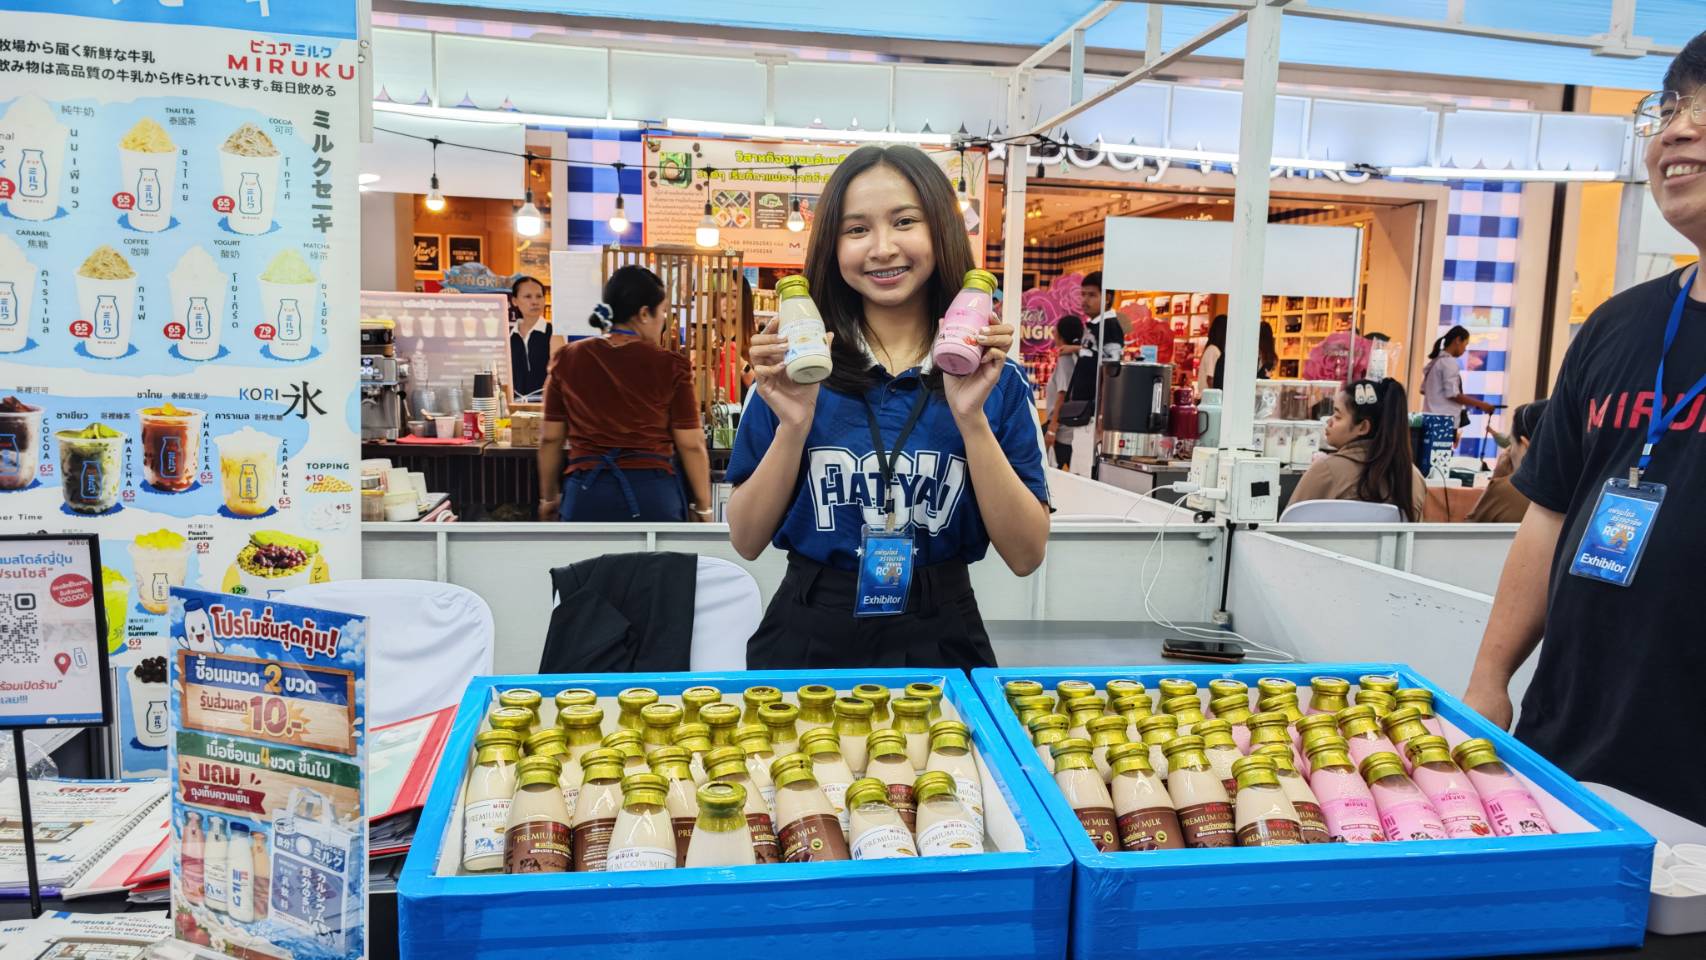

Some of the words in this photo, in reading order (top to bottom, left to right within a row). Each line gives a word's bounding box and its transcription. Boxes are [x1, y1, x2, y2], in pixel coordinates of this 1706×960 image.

[228, 55, 355, 80] MIRUKU
[312, 109, 334, 233] ミルクセーキ
[116, 194, 131, 204] 65
[217, 199, 230, 207] 65
[74, 323, 88, 332] 65
[258, 327, 271, 335] 79
[136, 389, 162, 399] ชาไทย
[239, 387, 279, 401] KORI
[281, 380, 327, 420] 氷
[56, 410, 89, 420] ชาเขียว
[215, 412, 250, 420] คาราเมล
[42, 418, 50, 460] COCOA
[125, 438, 133, 487] MATCHA
[306, 462, 350, 470] TOPPING
[39, 464, 54, 473] 65
[200, 471, 213, 480] 65
[122, 490, 135, 498] 65
[808, 446, 967, 537] PSU
[278, 497, 291, 506] 65
[196, 542, 209, 550] 69
[1580, 552, 1626, 573] Exhibitor
[231, 586, 247, 595] 129
[863, 595, 901, 605] Exhibitor
[210, 606, 338, 656] โปรโมชั่นสุดคุ้ม!
[128, 639, 142, 647] 69
[196, 654, 260, 687] ซื้อนมขวด
[264, 664, 283, 693] 2
[285, 677, 317, 695] ขวด
[200, 691, 248, 713] รับส่วนลด
[299, 750, 331, 778] ขึ้นไป
[198, 763, 241, 786] แถม
[191, 785, 250, 805] ถุงเก็บความเย็น
[1141, 818, 1162, 828] MILK
[1184, 814, 1217, 826] PREMIUM
[797, 826, 818, 838] MILK
[1244, 831, 1281, 844] PREMIUM
[517, 832, 557, 844] PREMIUM
